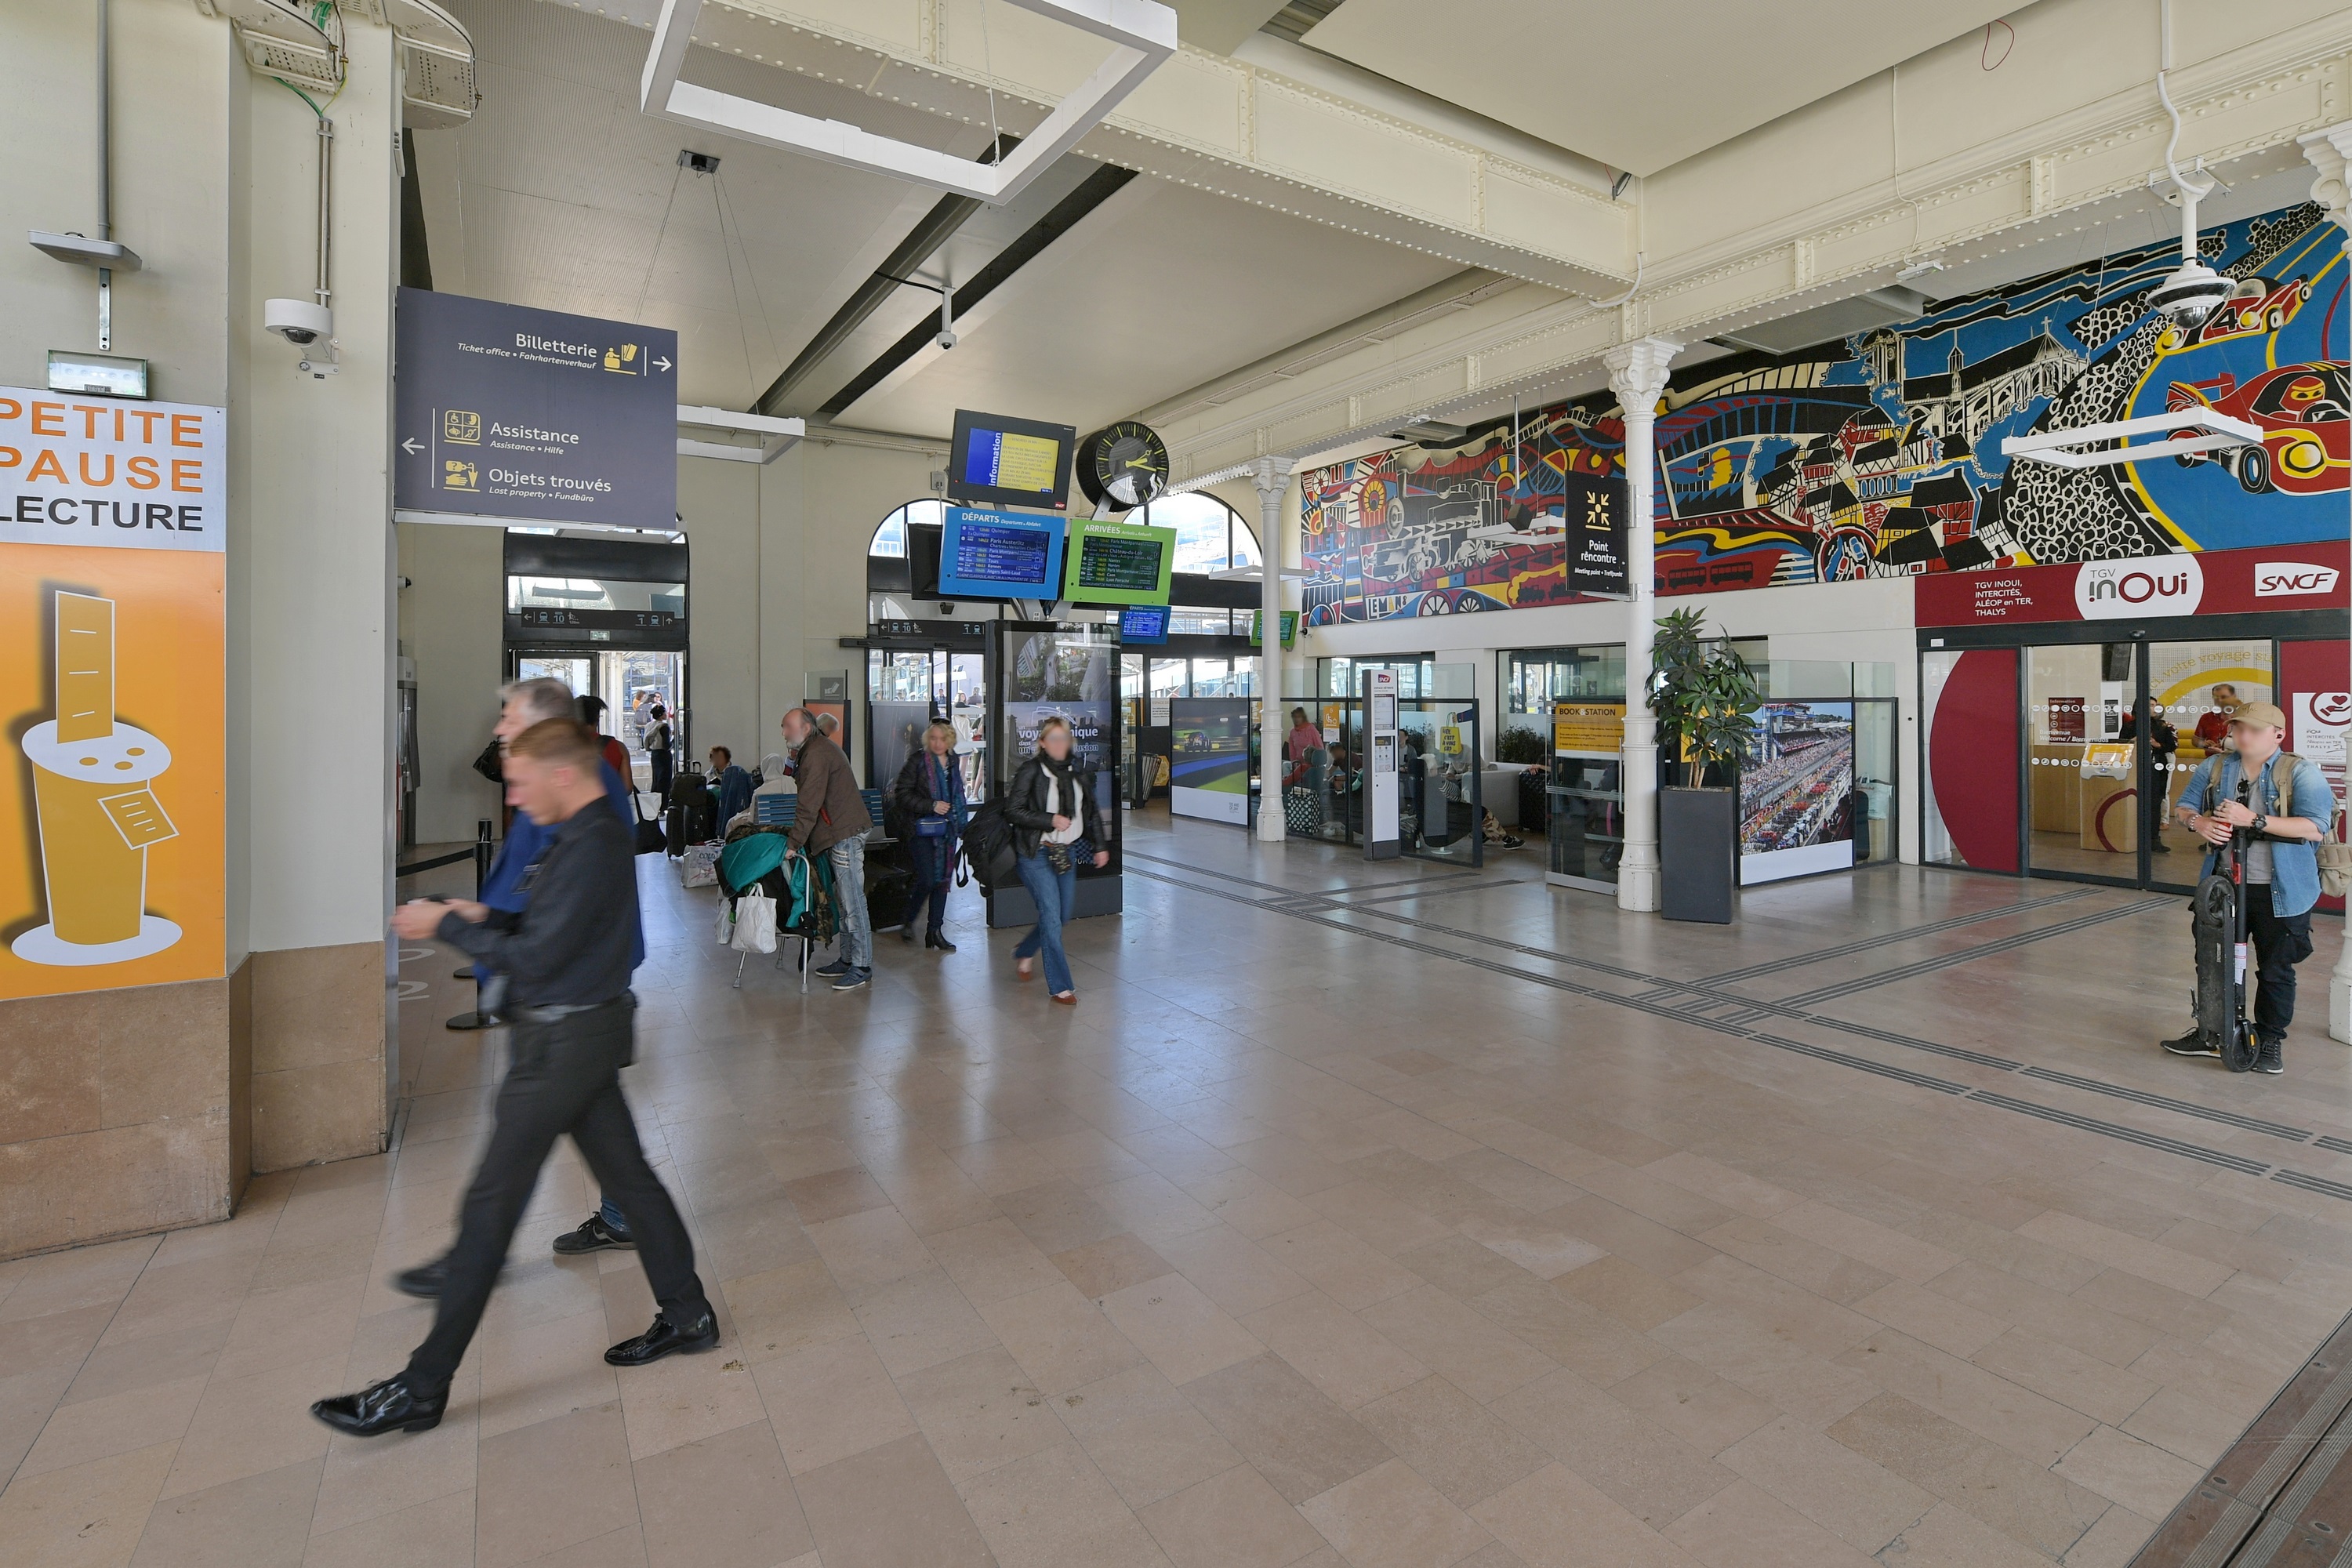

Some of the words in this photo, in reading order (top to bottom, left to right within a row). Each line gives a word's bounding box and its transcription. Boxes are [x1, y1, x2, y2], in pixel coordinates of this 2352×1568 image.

[2211, 307, 2238, 331] 4
[516, 333, 597, 358] Billetterie
[458, 343, 485, 354] Ticket
[486, 347, 510, 358] office
[519, 351, 597, 369] Fahrkartenverkauf
[490, 423, 579, 444] Assistance
[490, 440, 535, 452] Assistance
[544, 446, 564, 455] Hilfe
[988, 432, 1001, 487] information
[488, 468, 546, 488] Objets
[550, 474, 612, 492] trouvés
[489, 486, 508, 495] Lost
[510, 488, 546, 499] property
[962, 512, 1000, 524] DÉPARTS
[1084, 524, 1120, 535] ARRIVÉES
[1589, 539, 1609, 552] Point
[1574, 567, 1590, 575] Meeting
[2090, 568, 2116, 578] TGV
[1994, 579, 2023, 588] INOUI,
[2259, 572, 2332, 592] SNCF
[1975, 588, 2022, 598] INTERCITÉS,
[1975, 598, 2002, 608] ALÉOP
[2015, 597, 2033, 607] TER,
[1975, 608, 2006, 617] THALYS
[2162, 659, 2196, 677] votre
[2198, 651, 2251, 662] voyage
[1069, 726, 1098, 739] nique
